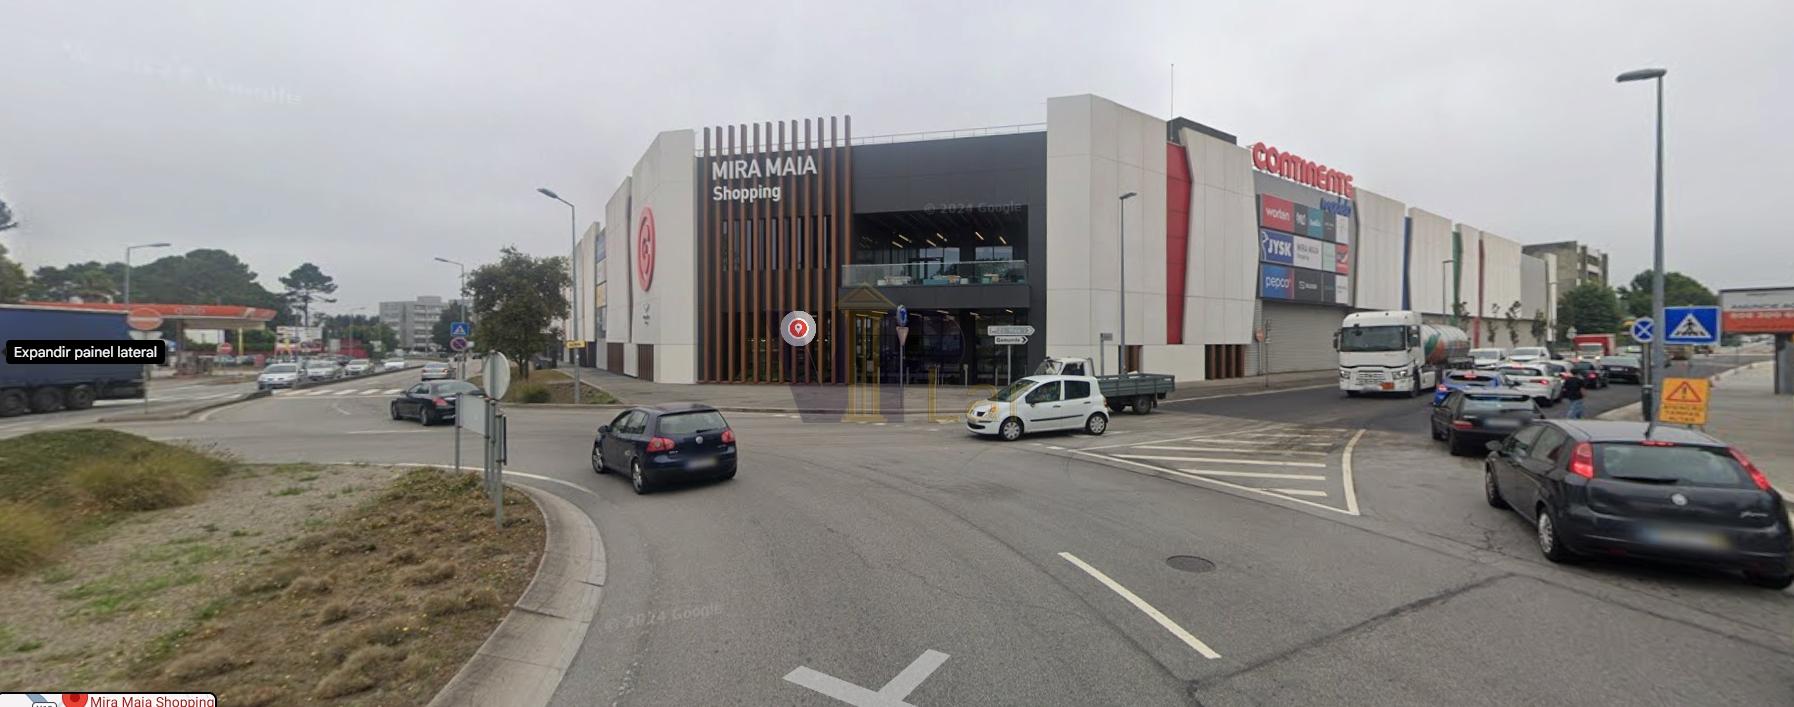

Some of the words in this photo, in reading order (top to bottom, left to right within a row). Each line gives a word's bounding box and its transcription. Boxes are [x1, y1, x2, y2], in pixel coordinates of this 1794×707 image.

[712, 159, 762, 180] MIRA
[765, 155, 817, 177] MAIA
[713, 185, 781, 203] Shopping
[1267, 238, 1292, 257] JYSK
[1265, 276, 1290, 288] pepco
